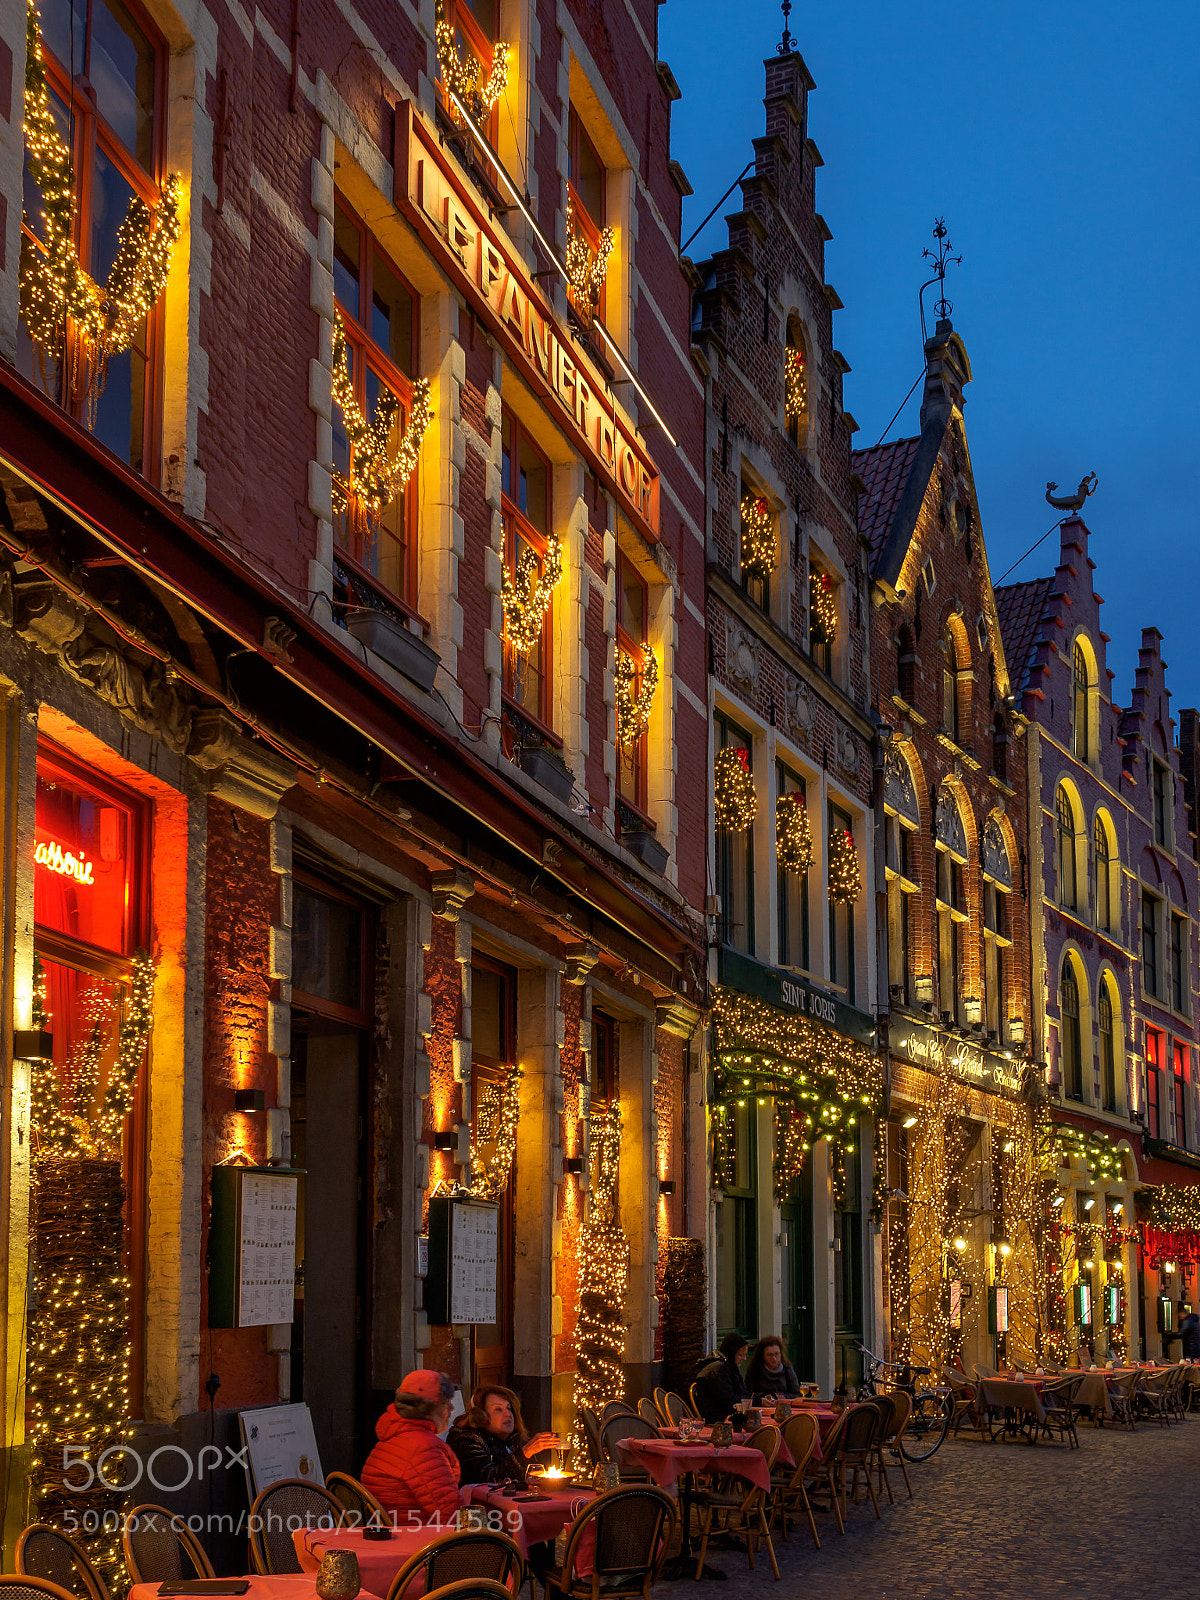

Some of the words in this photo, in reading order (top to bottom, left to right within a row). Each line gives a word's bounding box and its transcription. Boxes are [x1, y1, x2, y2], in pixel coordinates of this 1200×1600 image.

[418, 160, 474, 269] LE
[477, 230, 590, 437] PANIER
[782, 980, 806, 1010] SINT
[810, 993, 836, 1023] JORIS
